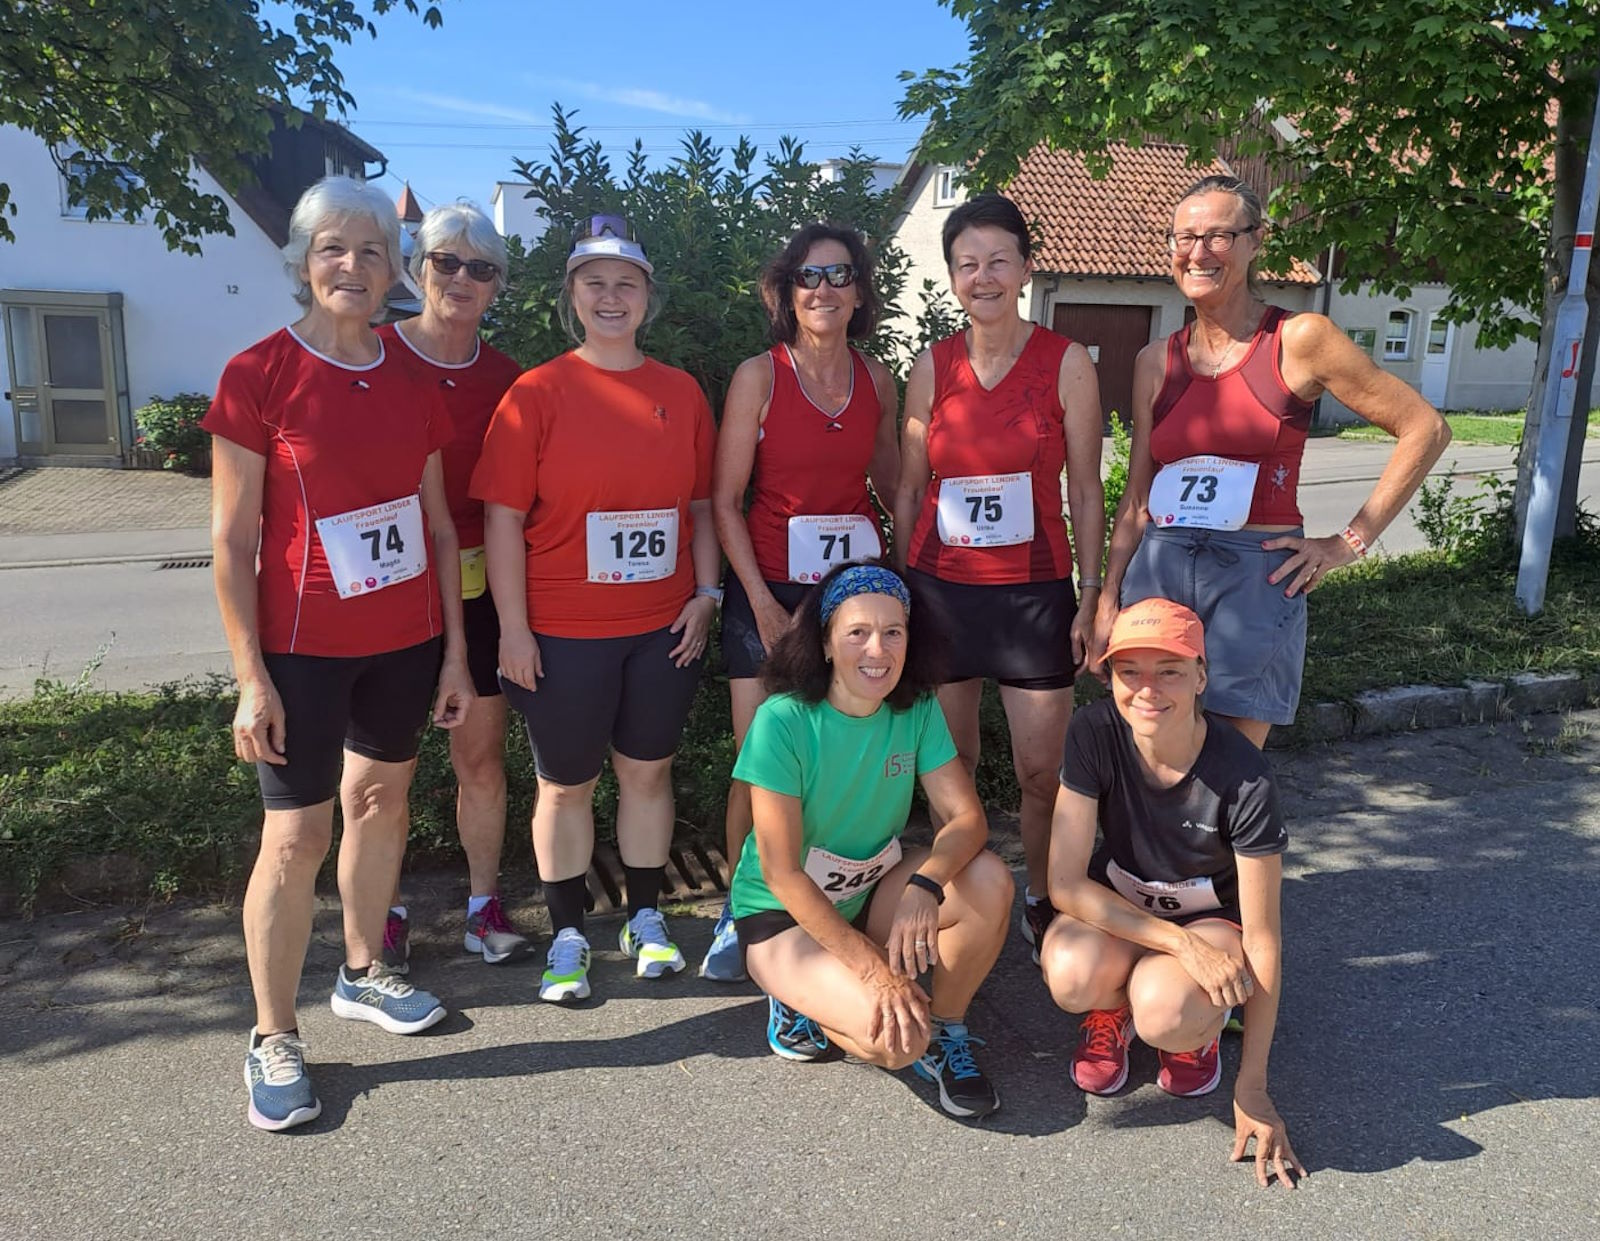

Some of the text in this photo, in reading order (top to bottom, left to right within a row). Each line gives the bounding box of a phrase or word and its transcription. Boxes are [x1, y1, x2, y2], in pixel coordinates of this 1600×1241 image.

[227, 284, 239, 295] 12
[1182, 466, 1225, 474] Frauenlauf
[949, 475, 1020, 486] LAUFSPORT LINDER
[963, 485, 1004, 493] Frauenlauf
[1179, 475, 1219, 504] 73
[331, 499, 412, 526] LAUFSPORT LINDER
[599, 511, 675, 521] LAUFSPORT LINDER
[964, 495, 1003, 523] 75
[355, 512, 398, 529] Frauenlauf
[617, 520, 659, 528] Frauenlauf
[359, 523, 405, 561] 74
[610, 529, 666, 559] 126
[819, 533, 850, 560] 71
[823, 864, 884, 892] 242
[1135, 890, 1182, 910] 76
